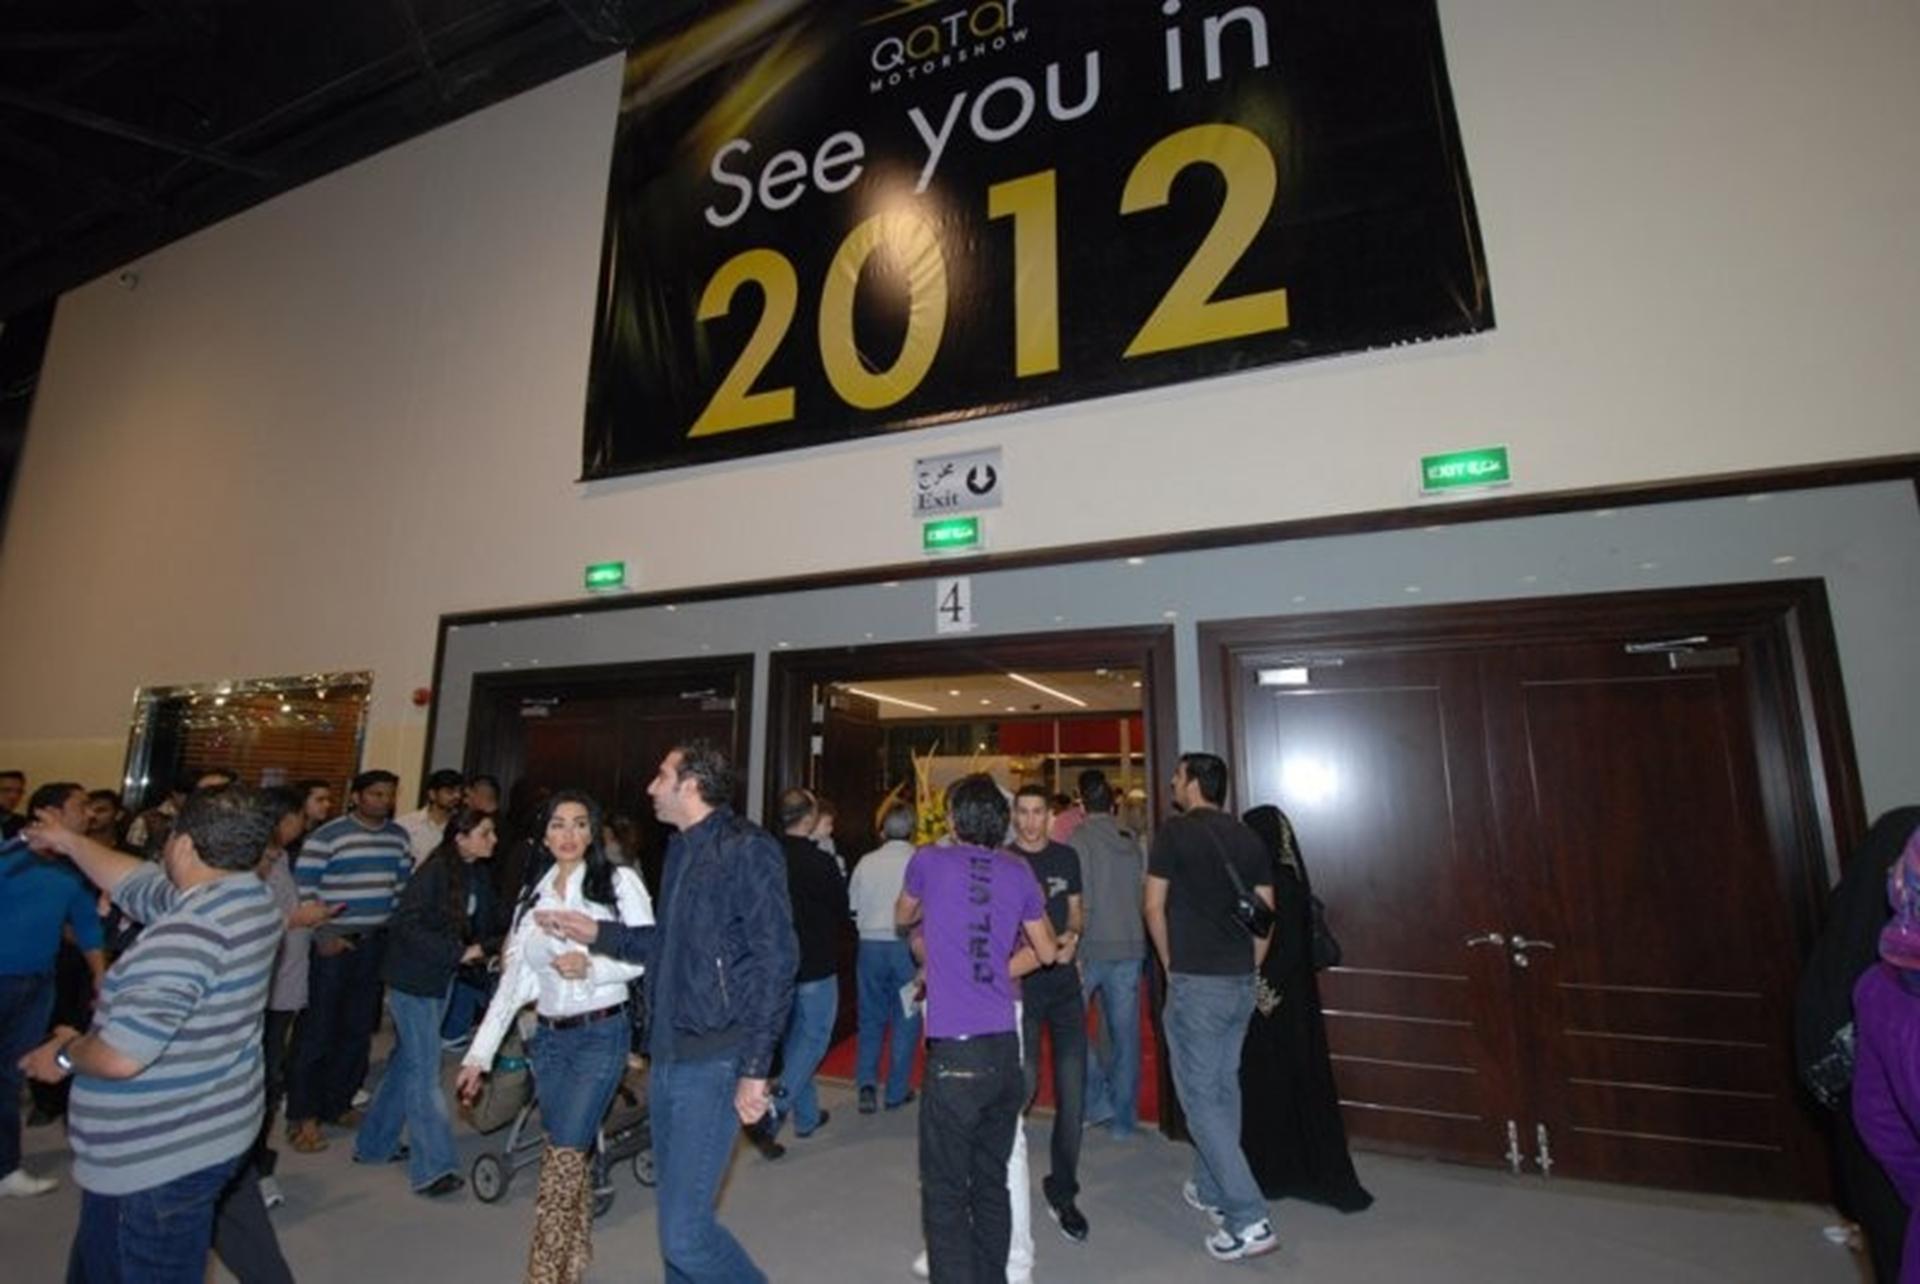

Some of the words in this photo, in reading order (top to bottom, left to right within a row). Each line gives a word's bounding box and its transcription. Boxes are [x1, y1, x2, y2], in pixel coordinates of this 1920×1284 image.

[870, 27, 1028, 93] MOTORSHOW
[704, 131, 865, 227] See
[907, 49, 1099, 194] you
[1162, 0, 1270, 92] in
[687, 123, 1289, 438] 2012
[918, 490, 958, 510] Exit
[939, 581, 964, 622] 4
